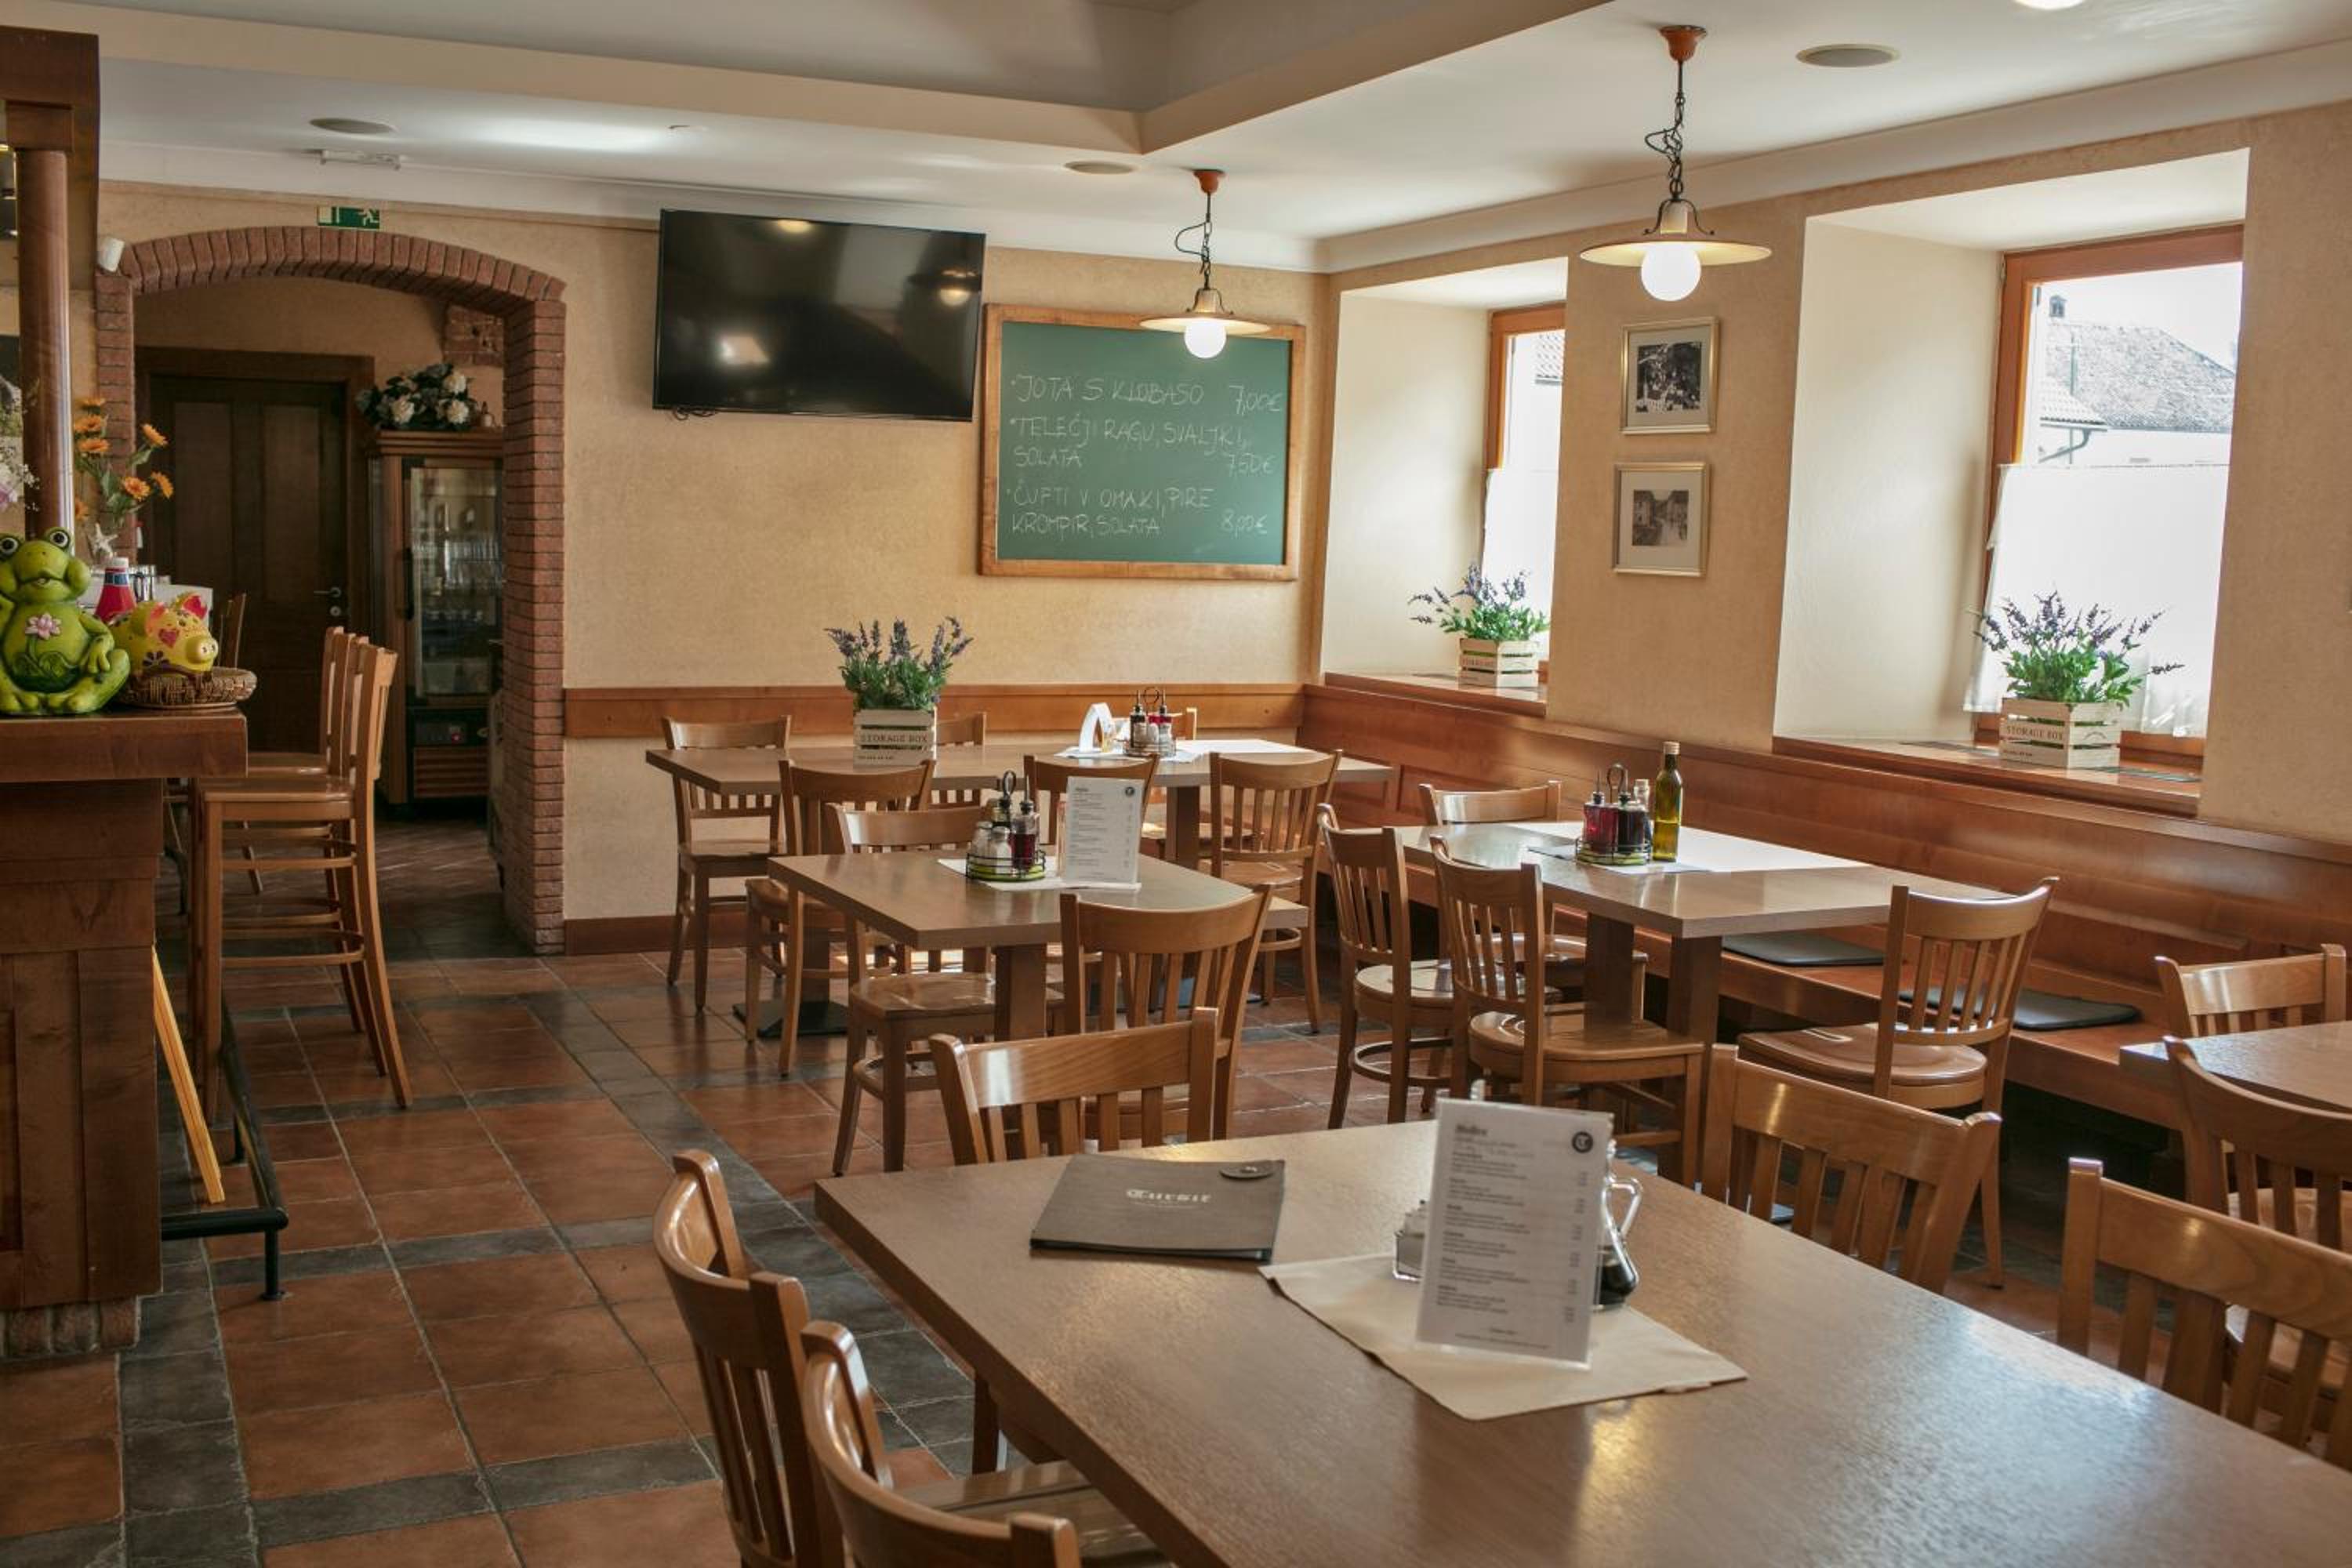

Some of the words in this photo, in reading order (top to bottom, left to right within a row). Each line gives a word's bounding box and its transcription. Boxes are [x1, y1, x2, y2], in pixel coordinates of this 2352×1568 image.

[1018, 374, 1073, 402] JOTA
[1081, 377, 1105, 401] S
[1112, 379, 1205, 405] KLOBASO
[1014, 445, 1083, 468] SOLATA
[1079, 488, 1089, 508] V
[1097, 514, 1161, 539] SOLATA
